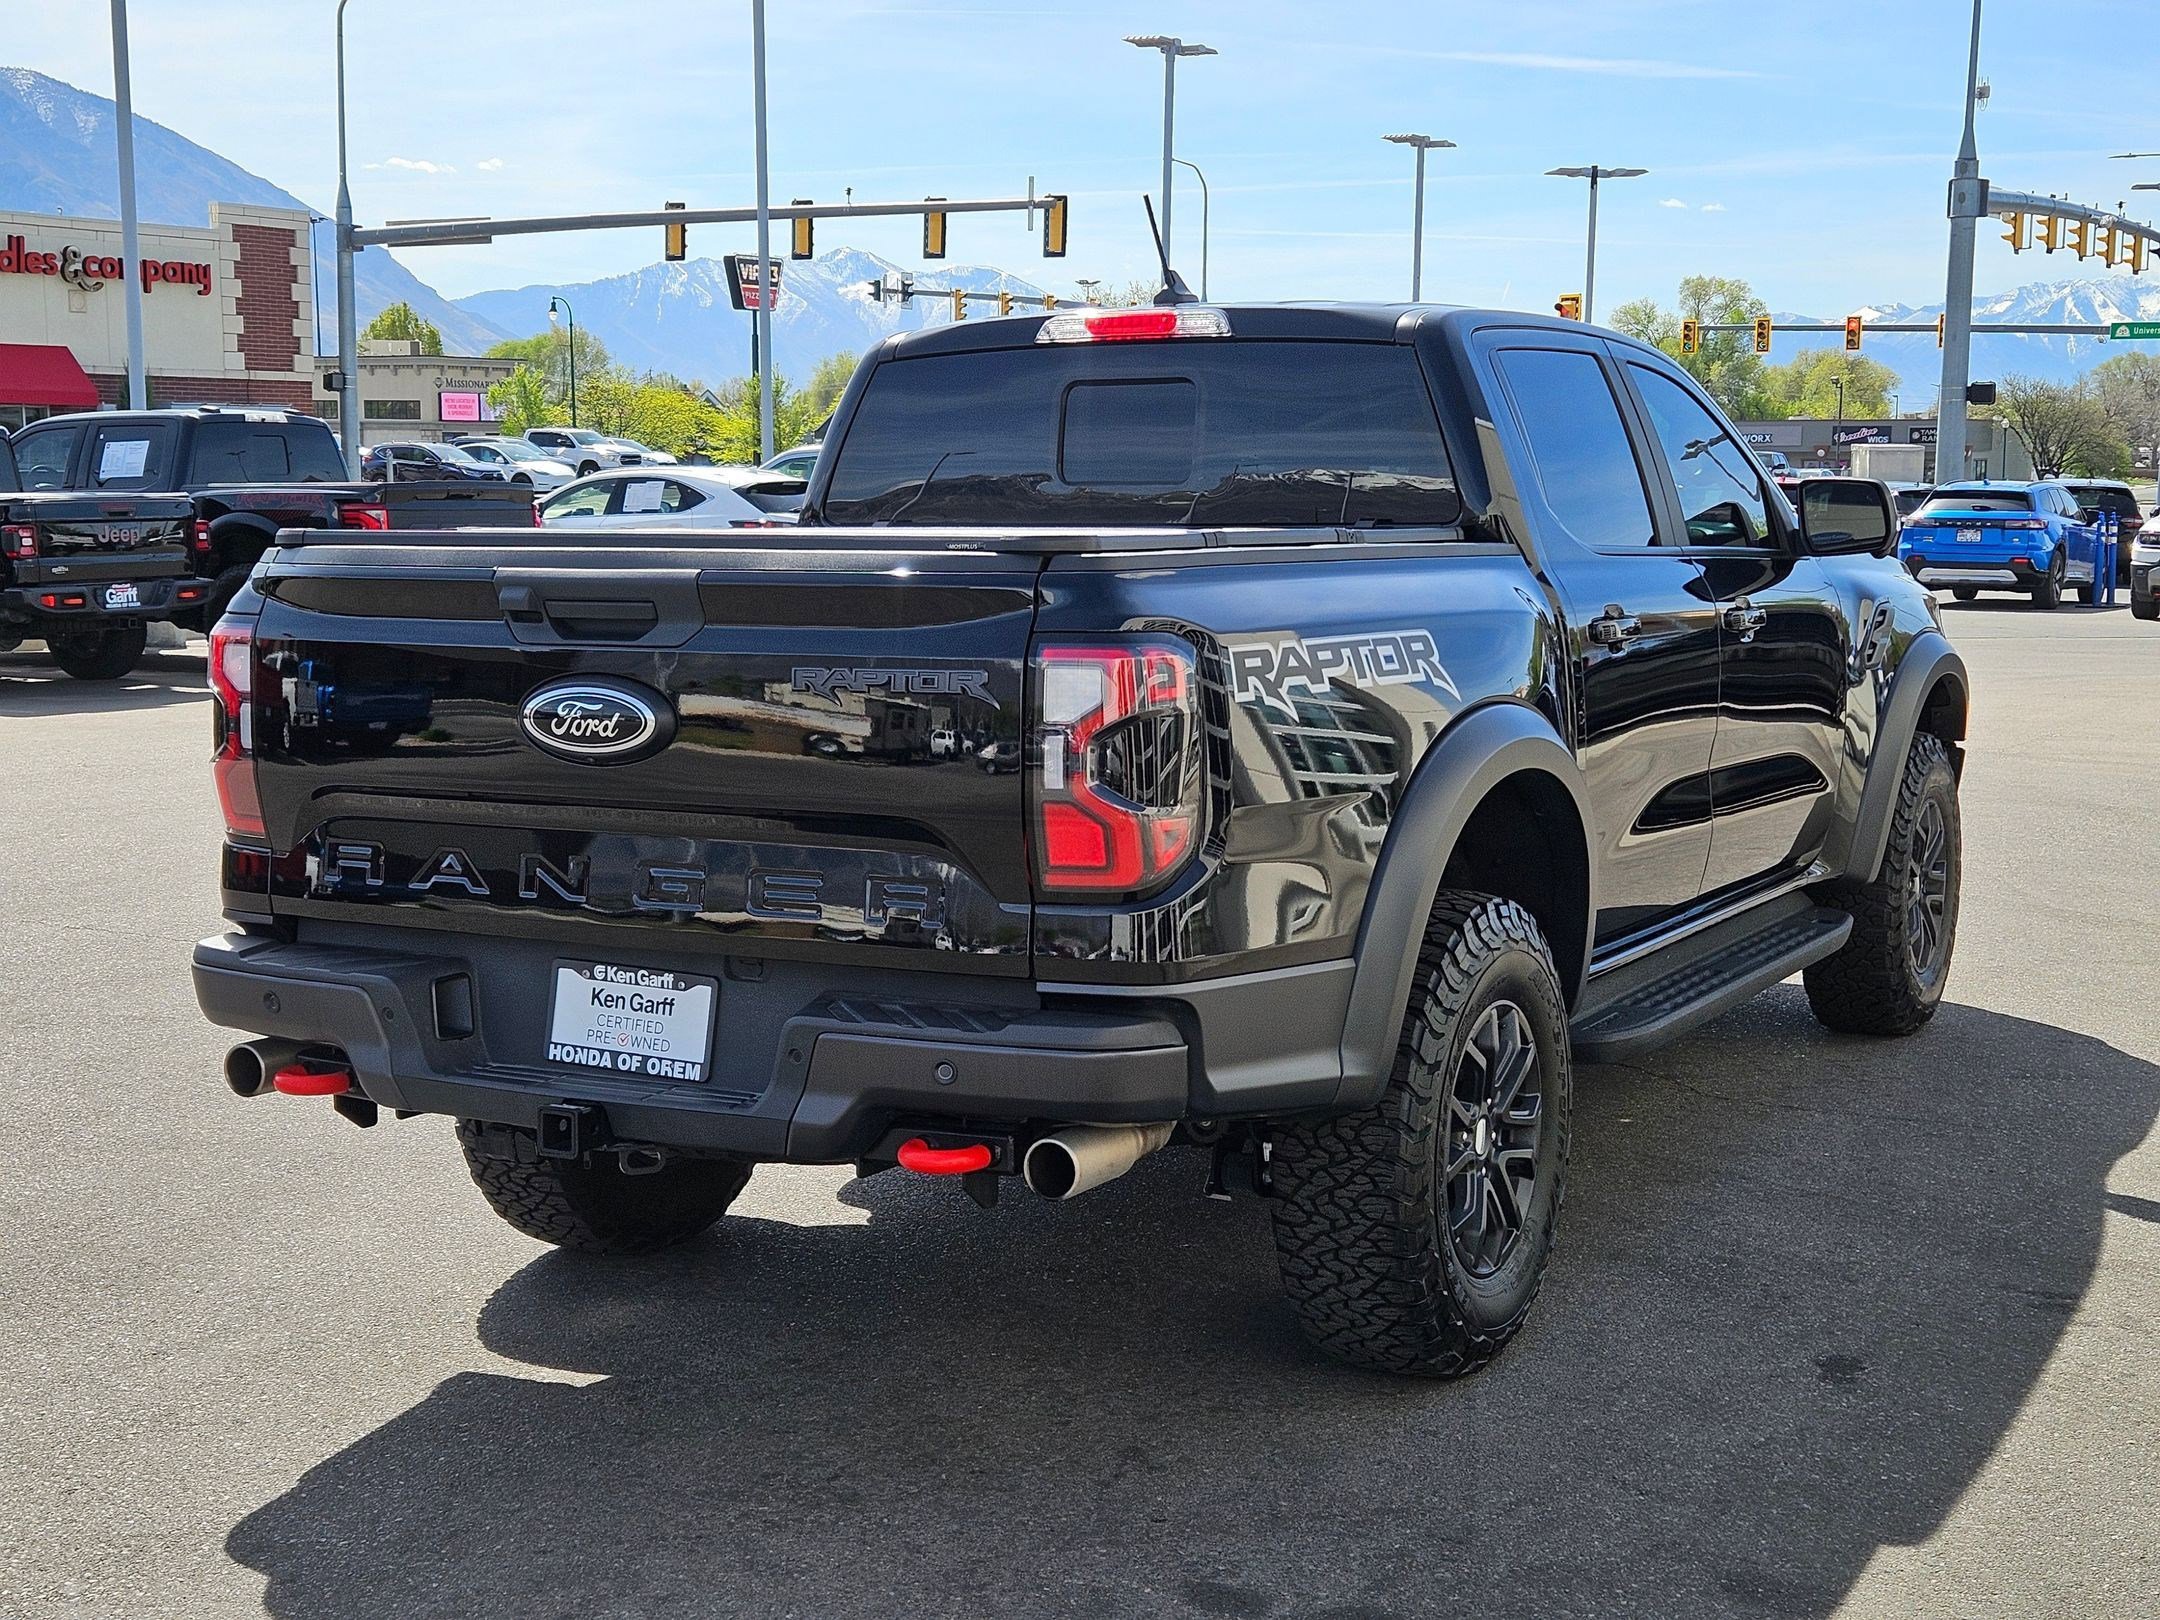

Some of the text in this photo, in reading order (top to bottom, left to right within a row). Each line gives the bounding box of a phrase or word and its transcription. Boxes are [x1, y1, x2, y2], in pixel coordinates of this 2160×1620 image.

[1867, 436, 1889, 444] WIGS
[98, 525, 140, 546] Jeep
[105, 587, 138, 604] Garff
[791, 667, 1000, 712] RAPTOR
[1228, 629, 1463, 724] RAPTOR
[550, 700, 622, 739] Ford
[322, 838, 947, 930] RANGER
[607, 965, 636, 985] Ken
[637, 969, 674, 989] Garff
[591, 987, 675, 1017] Ken Garff
[597, 1013, 664, 1035] CERTIFIED
[549, 1044, 701, 1081] HONDA OF OREM
